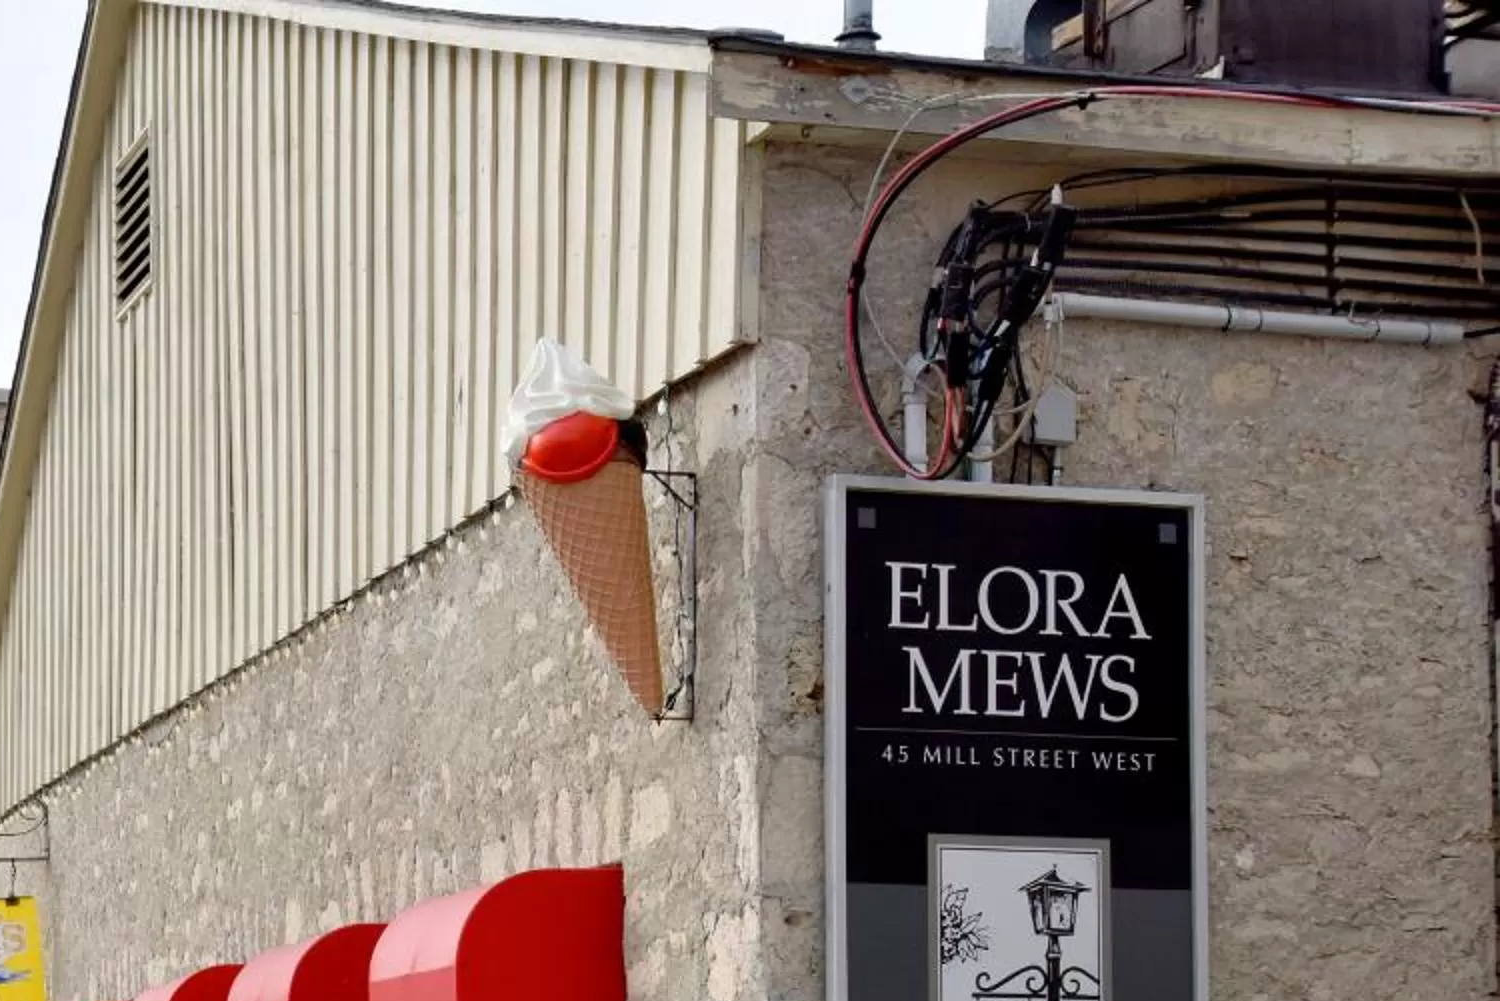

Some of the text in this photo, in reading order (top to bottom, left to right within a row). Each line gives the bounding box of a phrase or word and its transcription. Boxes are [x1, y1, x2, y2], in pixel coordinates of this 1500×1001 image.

[885, 561, 1153, 640] ELORA
[901, 646, 1139, 722] MEWS
[880, 744, 1156, 772] 45 MILL STREET WEST
